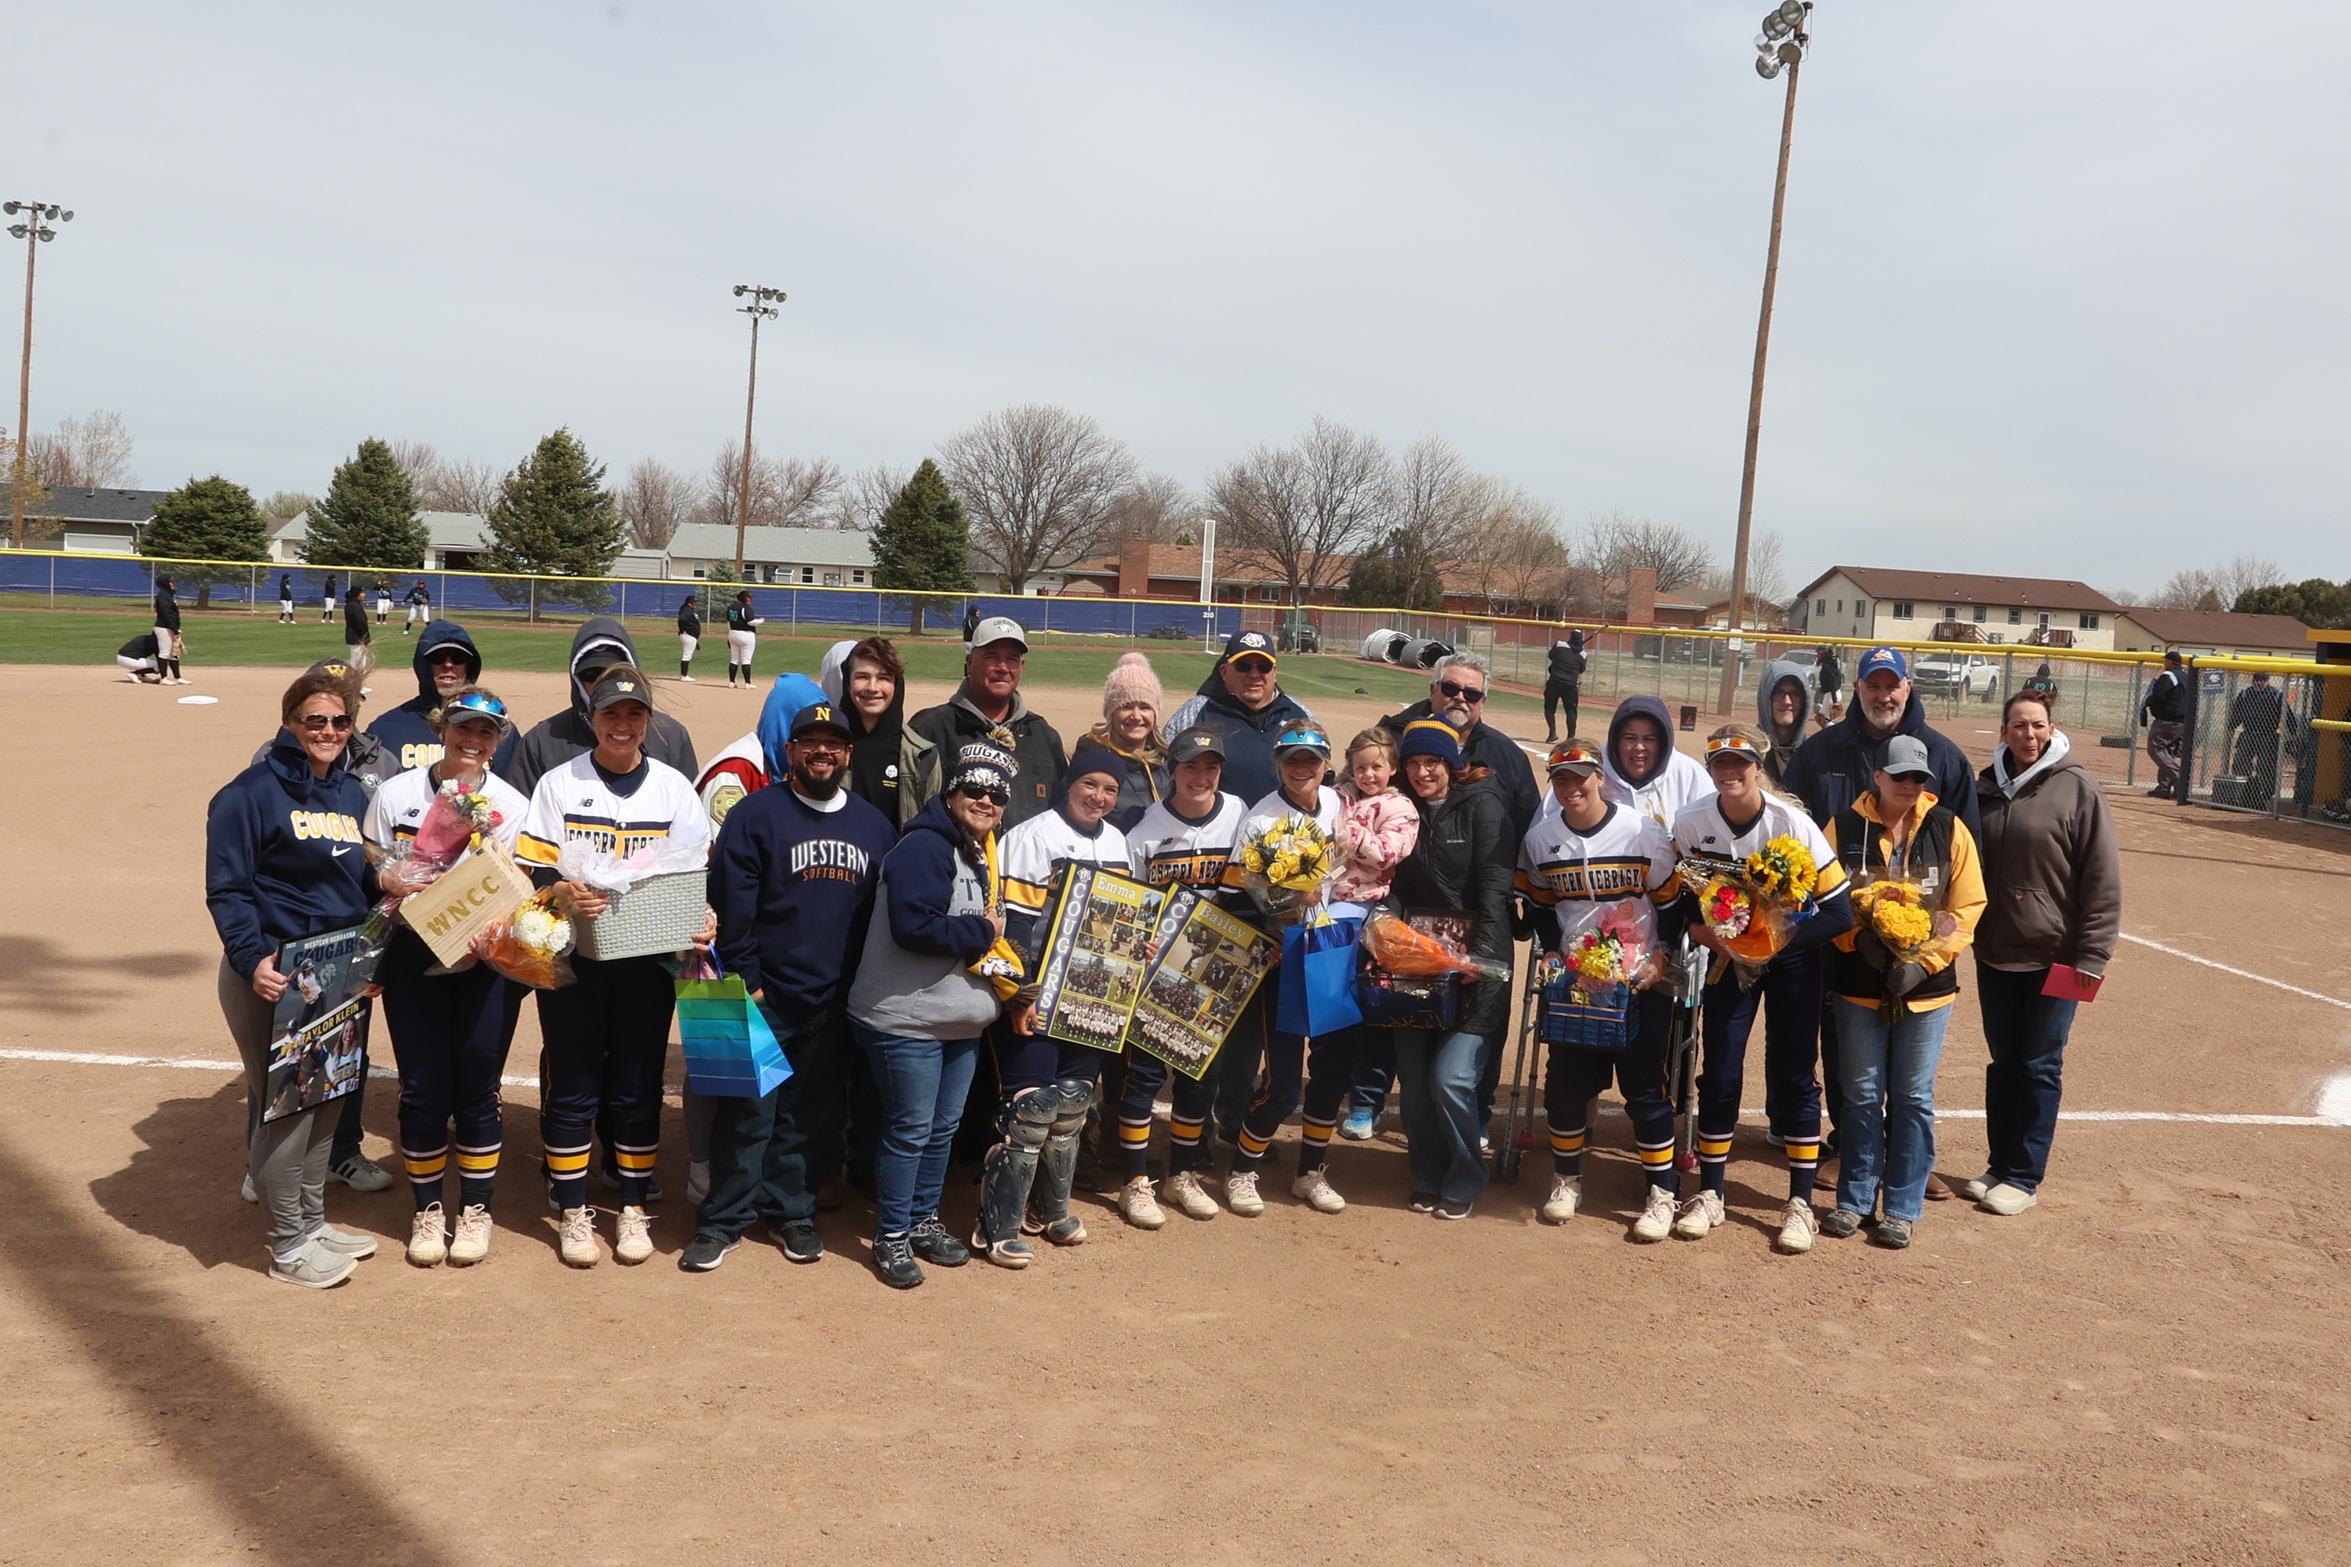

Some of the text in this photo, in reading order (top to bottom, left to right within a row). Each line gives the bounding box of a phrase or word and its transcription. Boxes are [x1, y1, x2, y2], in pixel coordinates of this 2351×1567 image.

[1203, 611, 1214, 619] 210
[815, 706, 831, 721] N
[790, 839, 869, 877] WESTERN
[802, 867, 857, 885] SOFTBALL
[1097, 876, 1137, 901] Emma
[426, 875, 500, 937] WNCC
[1199, 905, 1247, 940] Bailey
[1039, 882, 1087, 1010] COUGARS
[335, 1002, 360, 1025] KLEIN
